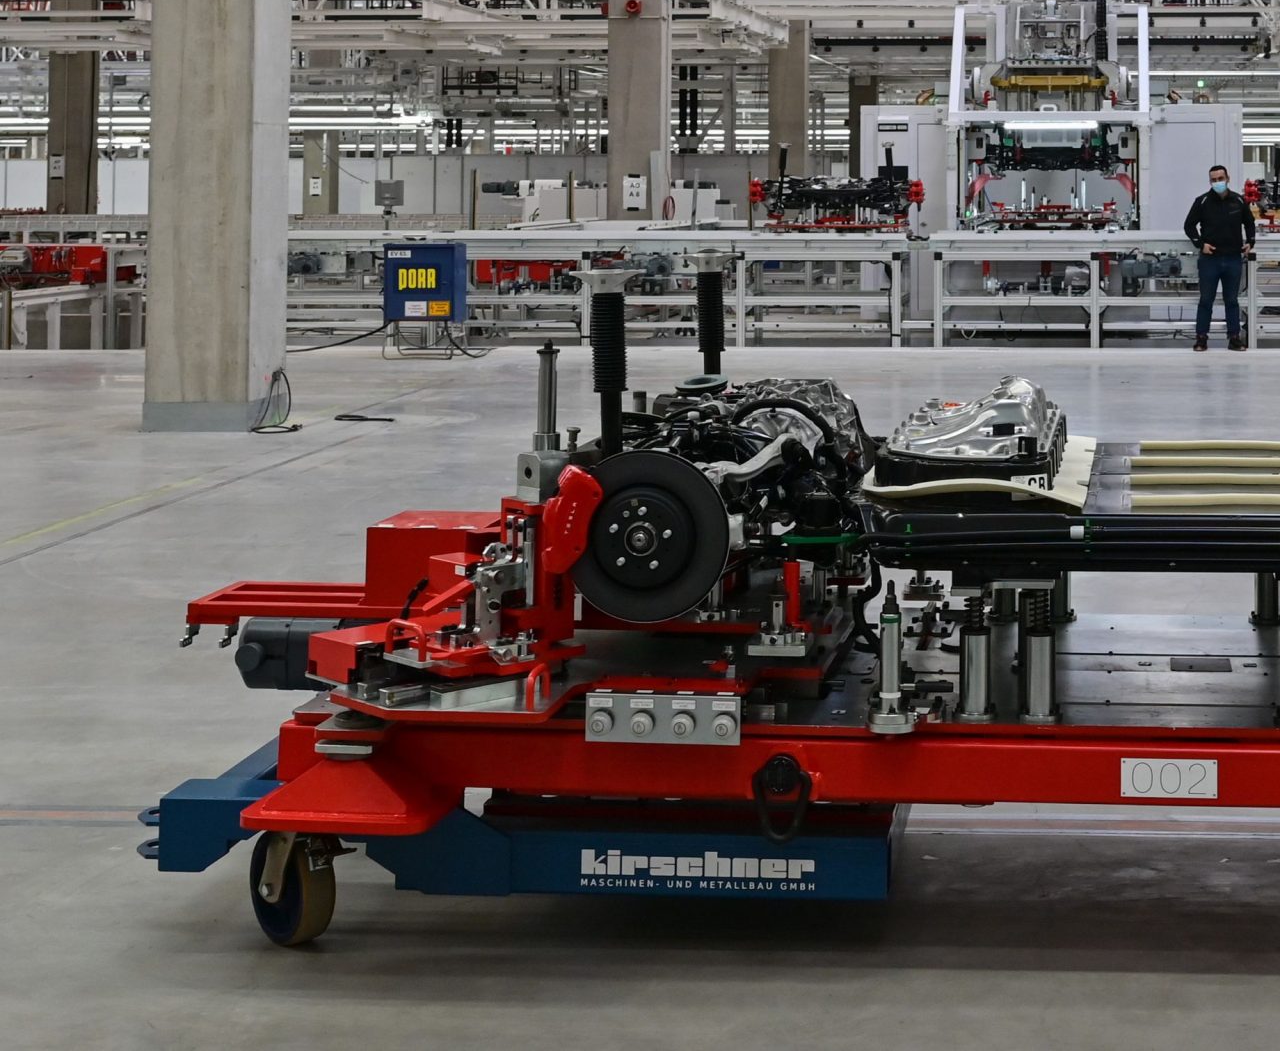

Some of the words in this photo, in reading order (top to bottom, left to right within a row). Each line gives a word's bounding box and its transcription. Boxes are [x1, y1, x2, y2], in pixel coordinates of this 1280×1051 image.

[1131, 762, 1207, 795] 002
[581, 849, 815, 879] kirschner
[580, 878, 660, 888] MASCHINEN-
[667, 880, 692, 888] UND
[700, 880, 773, 890] METALLBAU
[780, 882, 816, 891] GMBH
